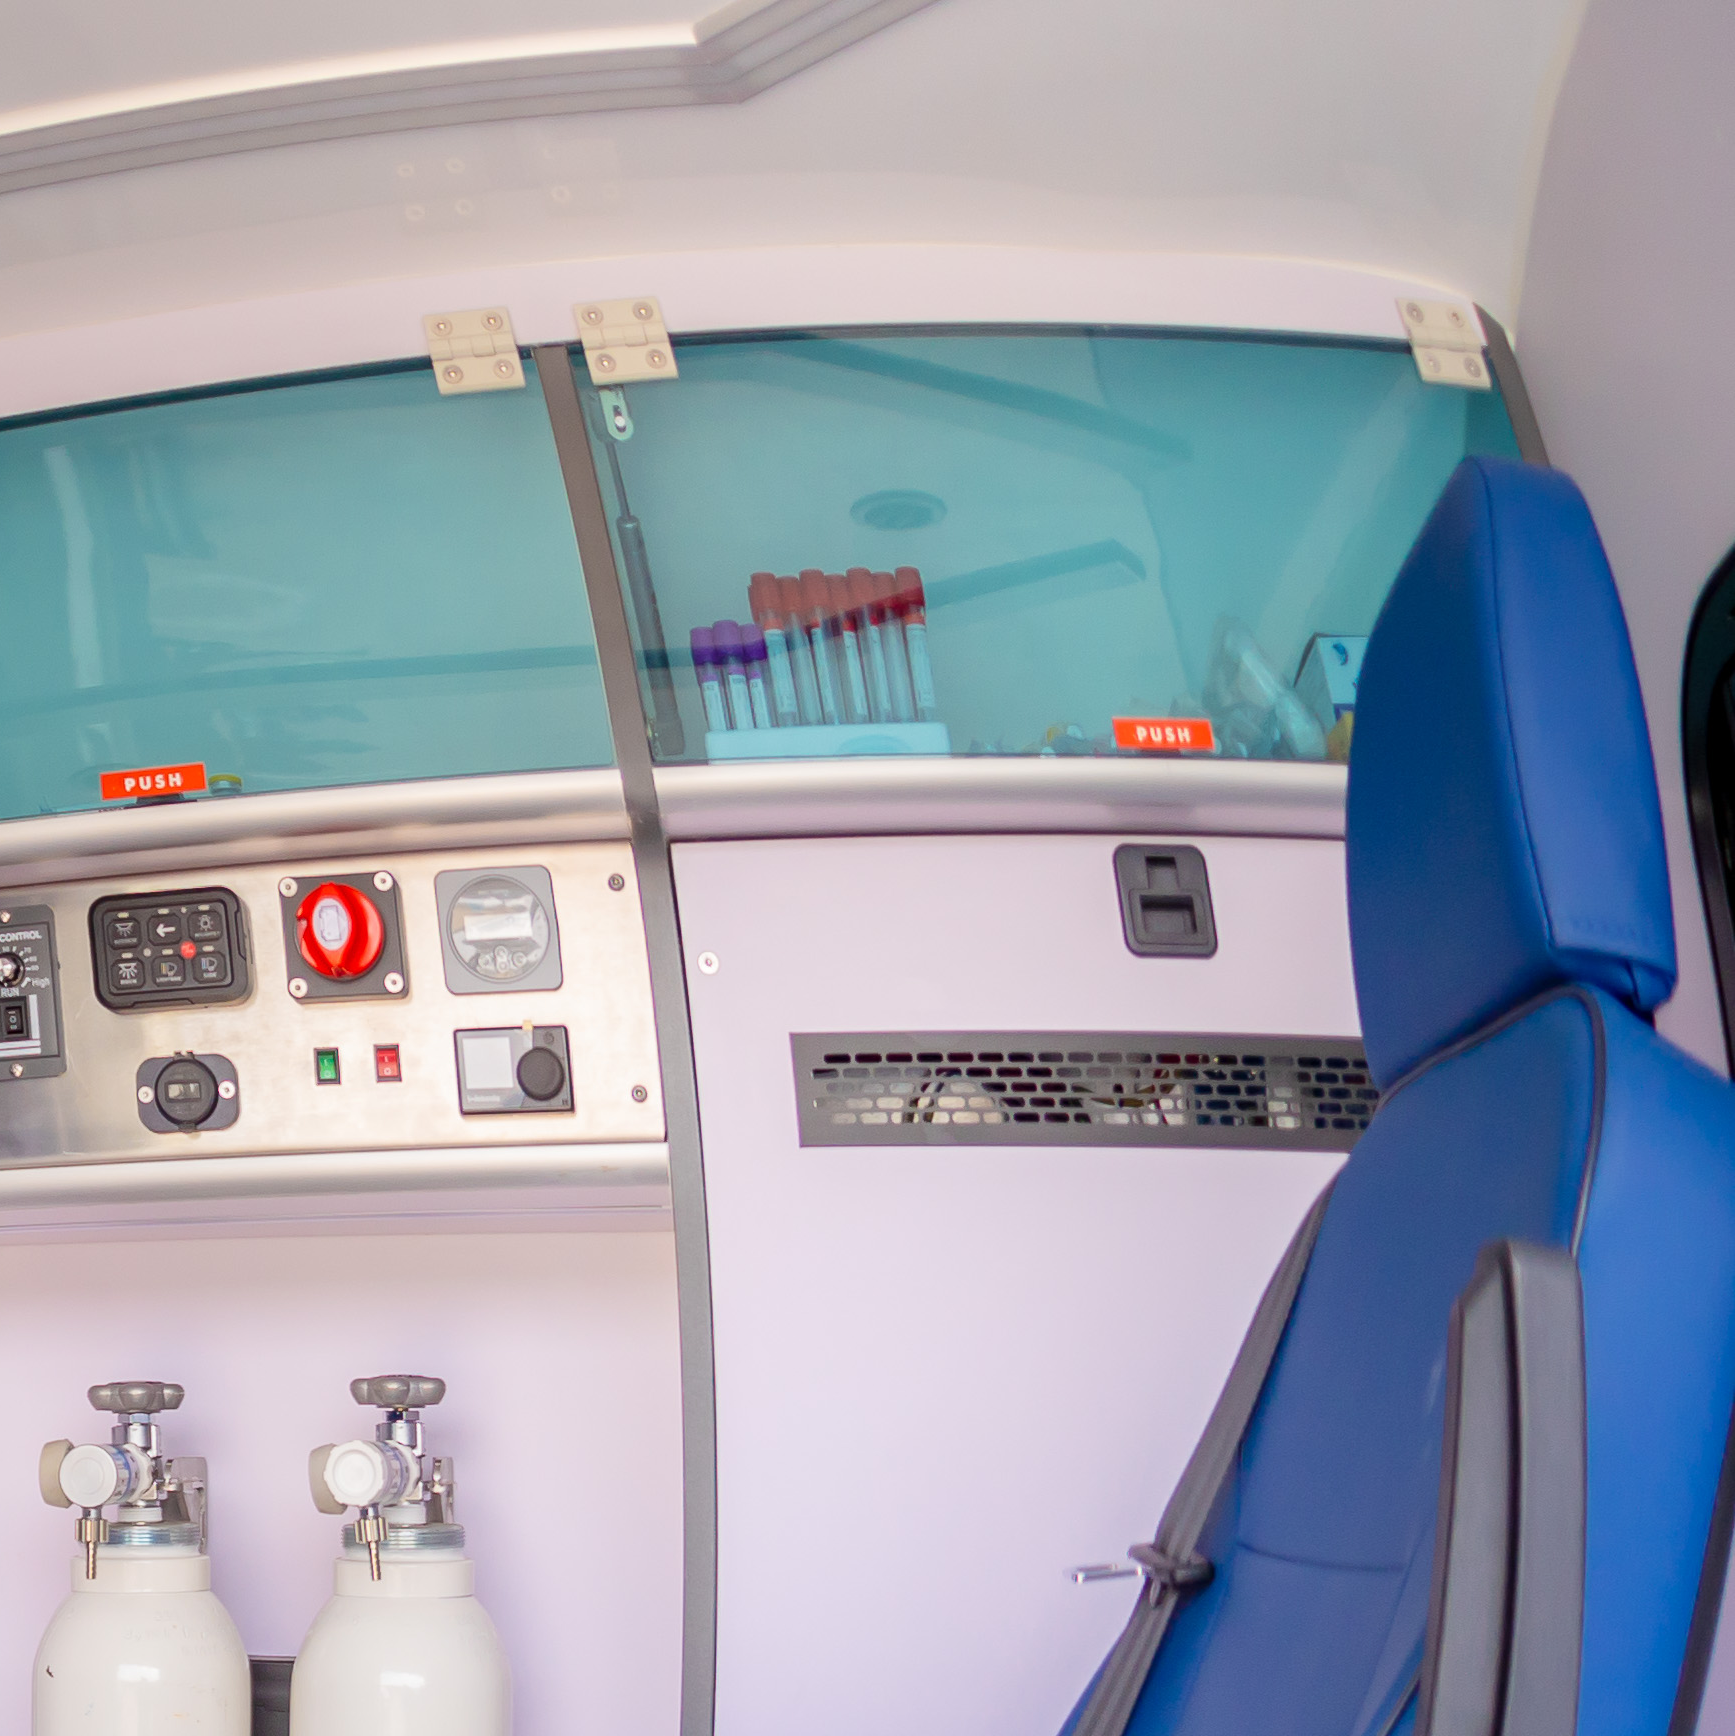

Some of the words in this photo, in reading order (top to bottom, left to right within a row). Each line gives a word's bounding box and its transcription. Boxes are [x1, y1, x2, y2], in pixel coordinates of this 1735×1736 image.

[1135, 725, 1191, 744] PUSH
[123, 772, 183, 792] PUSH
[31, 976, 50, 989] High
[0, 987, 20, 997] RUN
